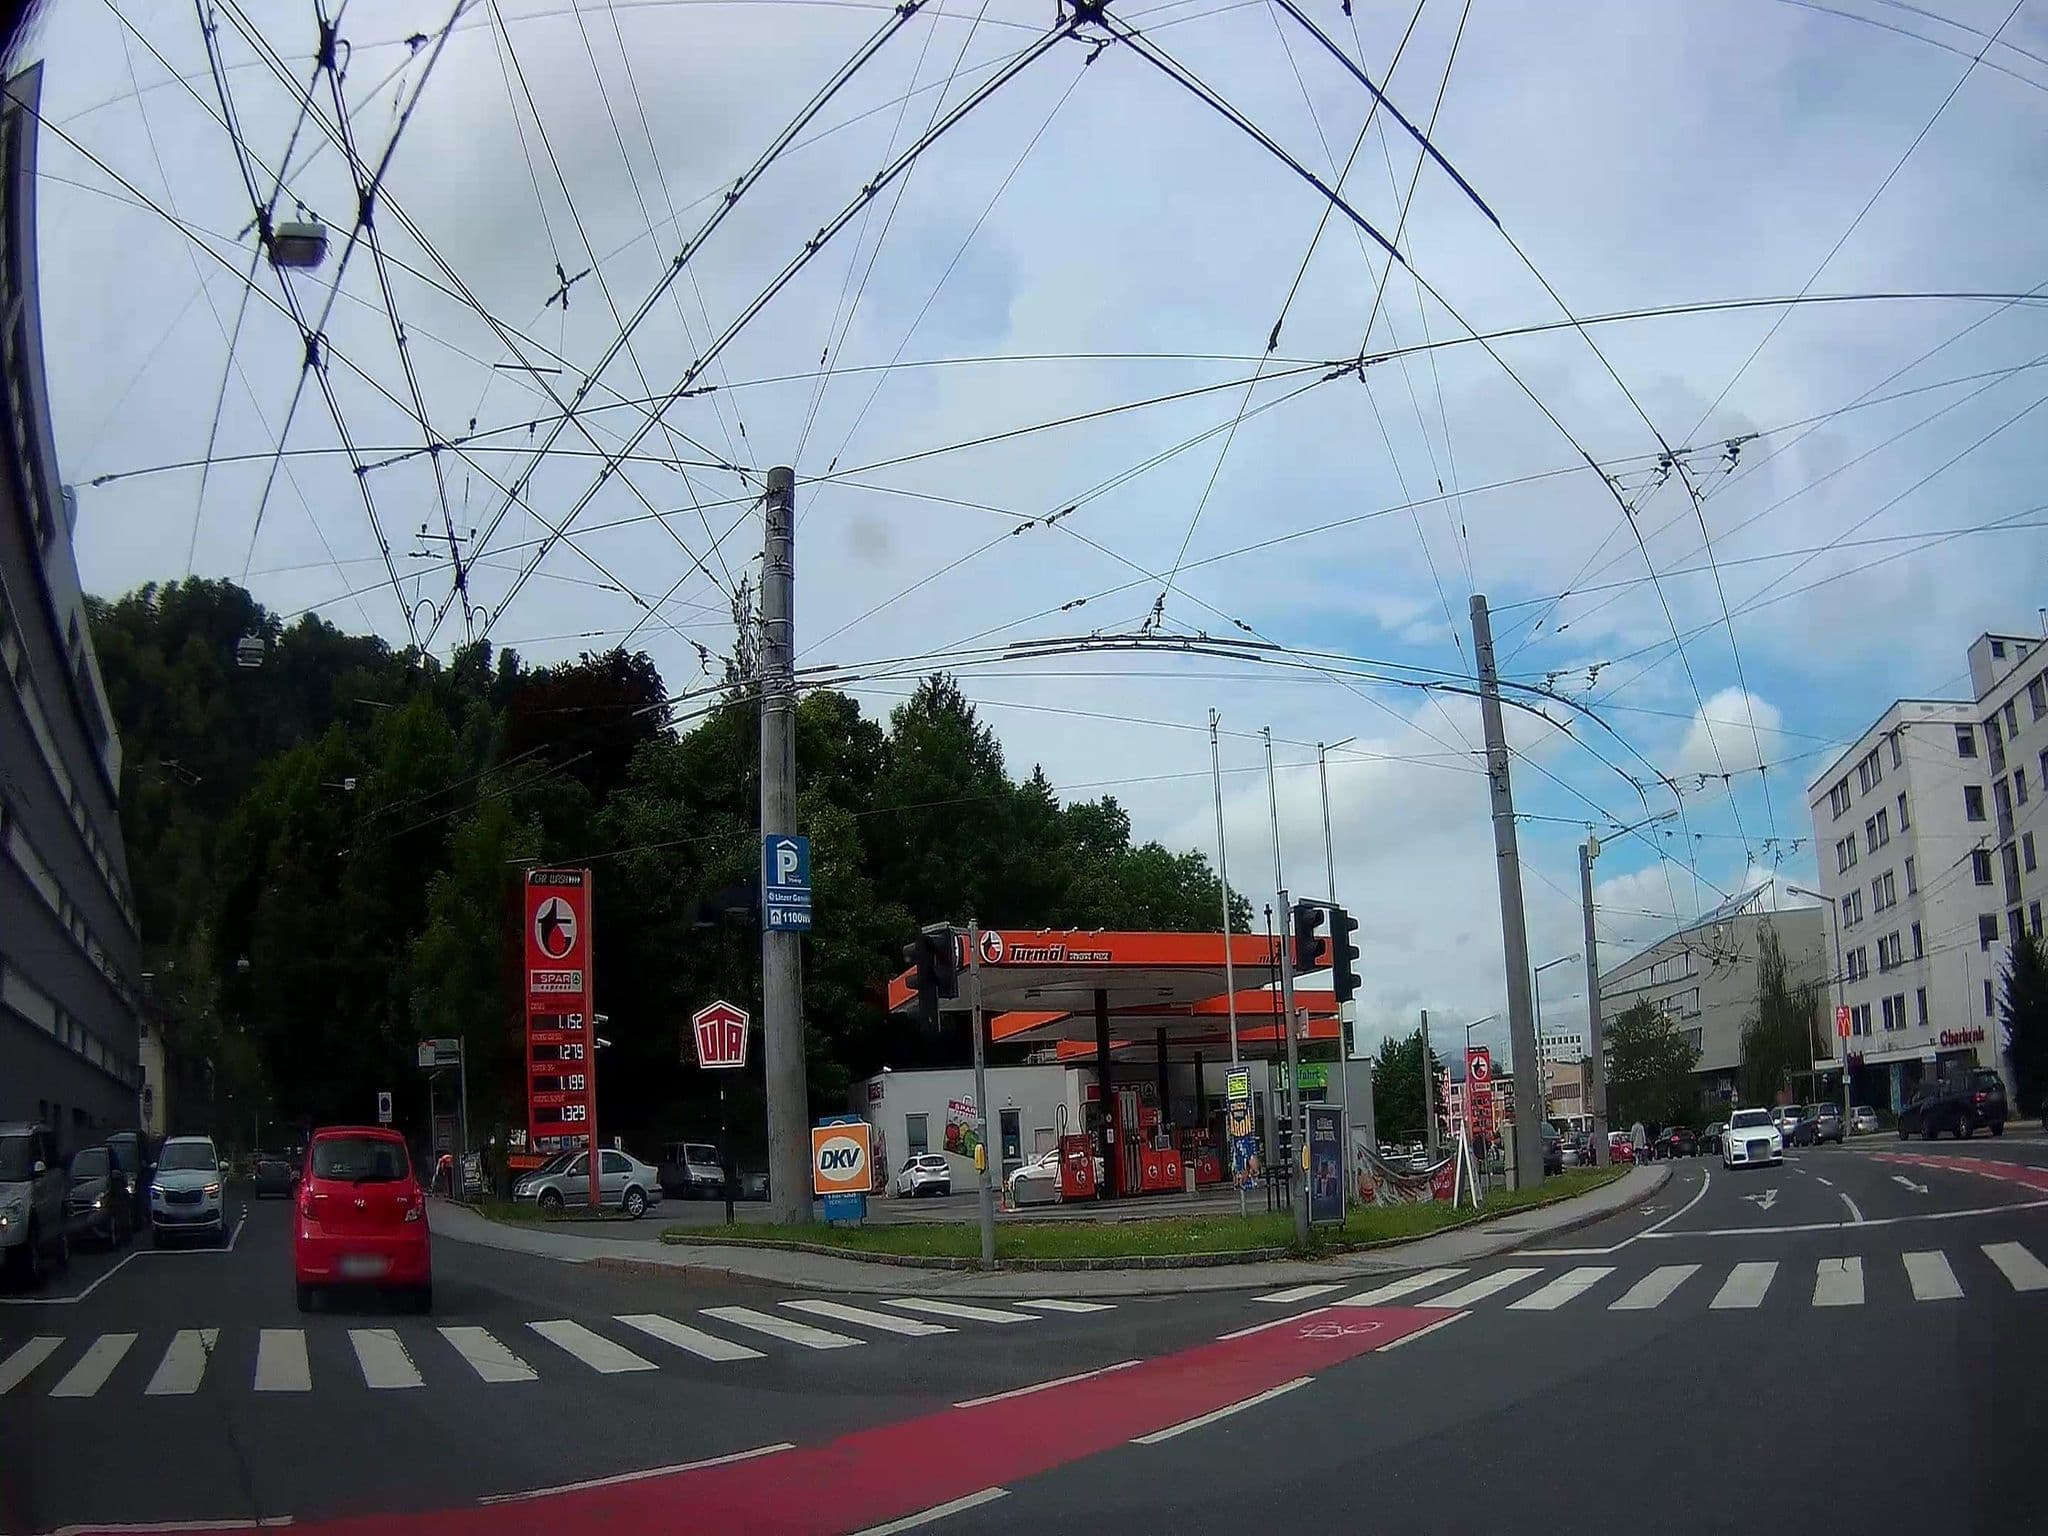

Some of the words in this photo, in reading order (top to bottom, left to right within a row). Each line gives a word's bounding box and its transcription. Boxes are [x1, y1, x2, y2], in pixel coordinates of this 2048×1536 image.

[777, 849, 799, 885] P
[1009, 944, 1066, 963] Turmöl
[540, 974, 571, 984] SPAR
[558, 1013, 583, 1030] 1.152
[559, 1044, 584, 1060] 1.279
[560, 1074, 585, 1091] 1.199
[561, 1105, 587, 1121] 1.329
[820, 1147, 861, 1171] DKV
